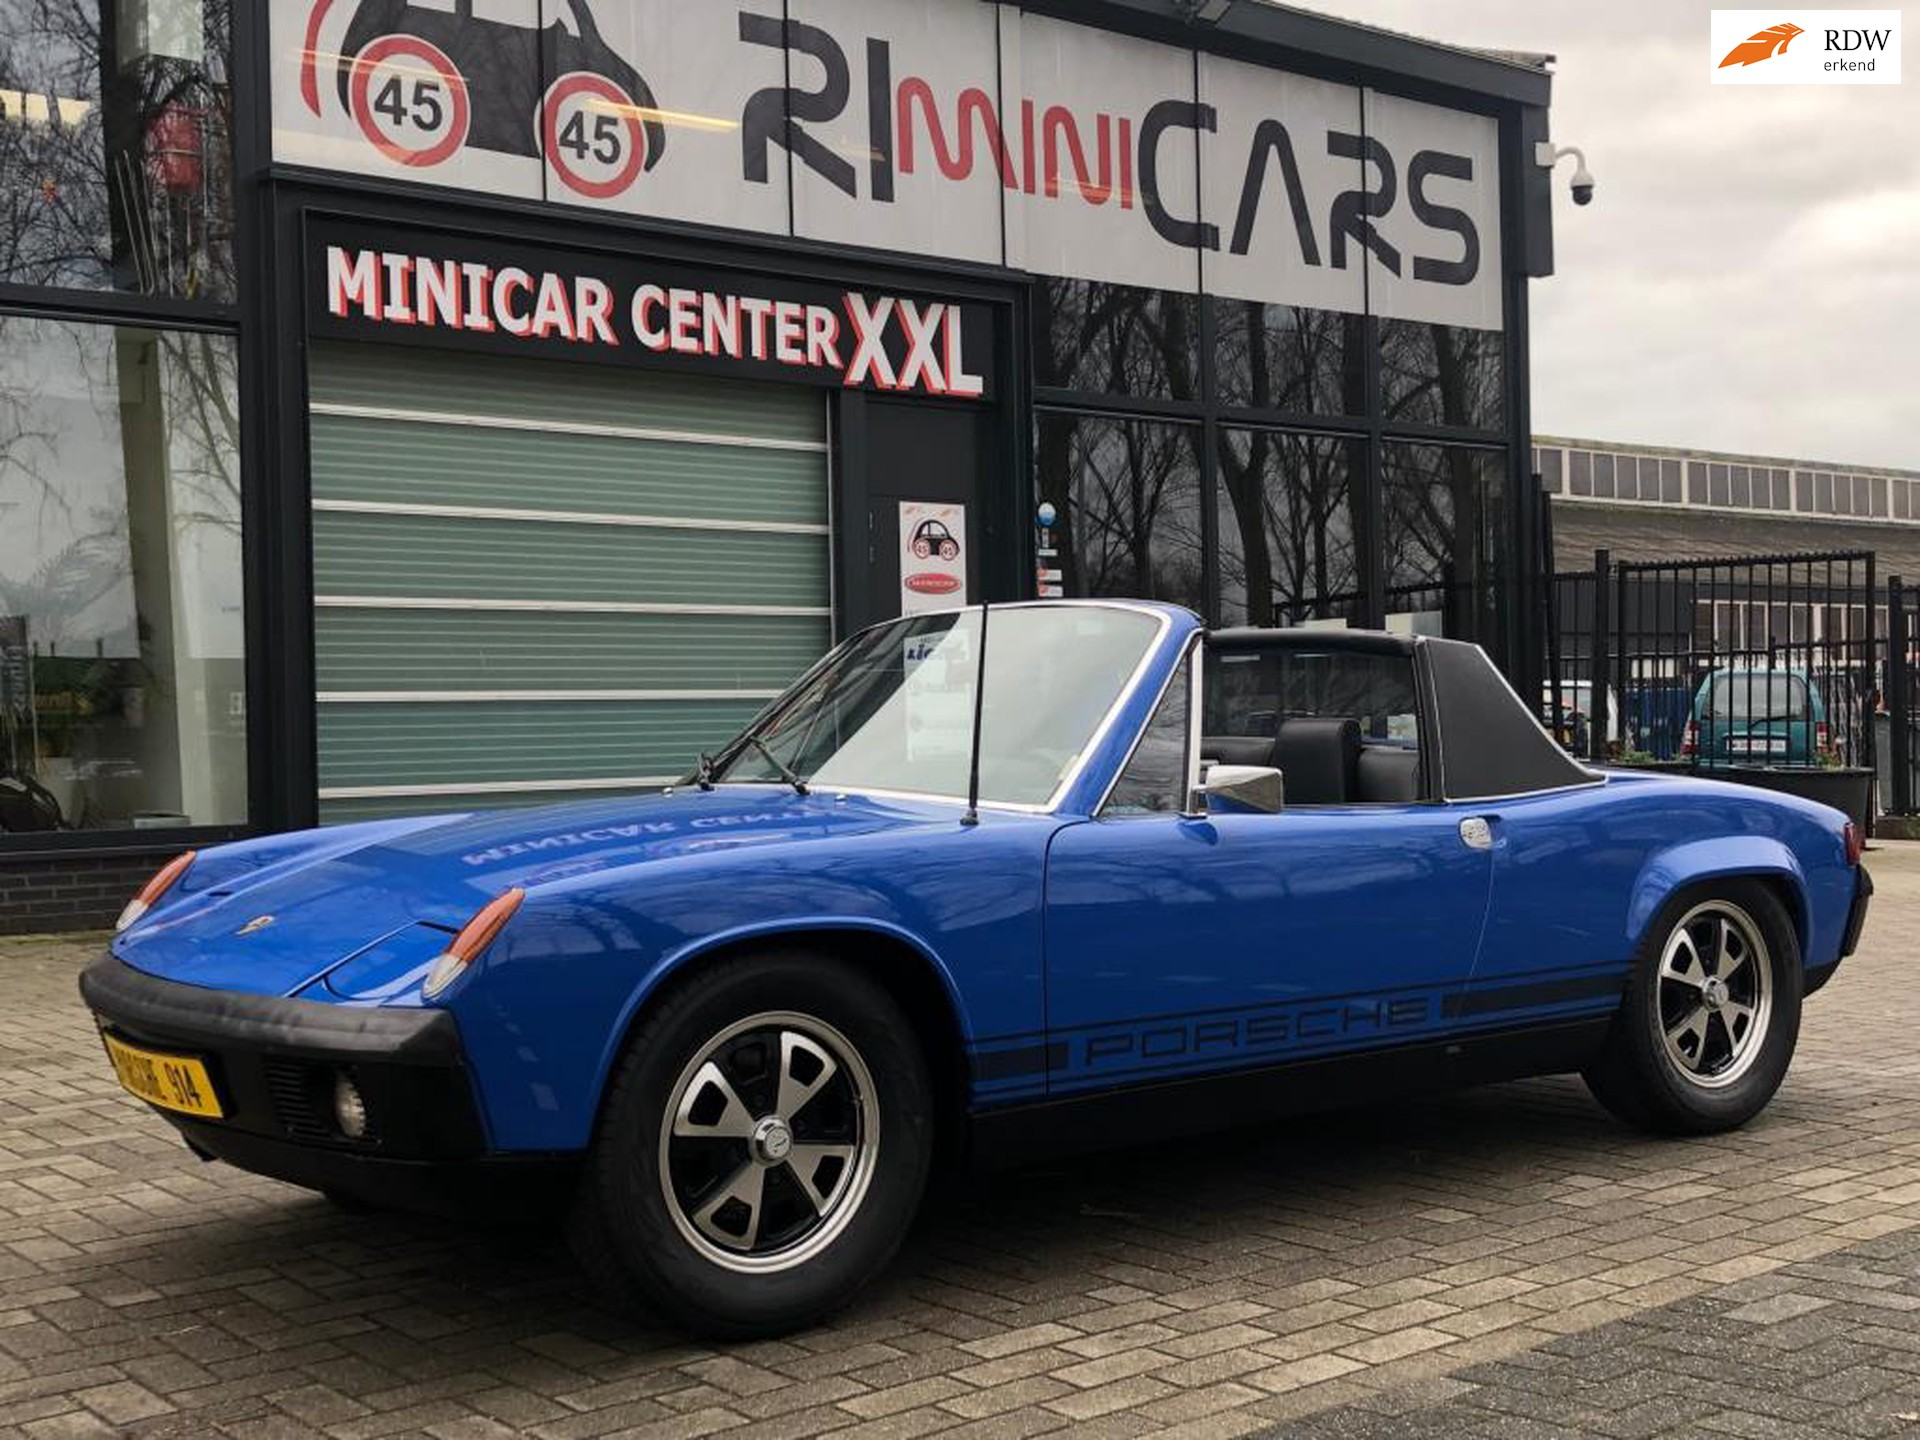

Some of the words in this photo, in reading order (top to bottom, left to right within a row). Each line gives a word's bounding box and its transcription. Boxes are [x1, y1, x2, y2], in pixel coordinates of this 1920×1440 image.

[374, 76, 443, 132] 45
[558, 110, 621, 164] 45
[326, 246, 619, 345] MINICAR
[631, 284, 843, 368] CENTER
[842, 293, 984, 394] XXL
[1086, 998, 1429, 1065] PORSCHE
[164, 1062, 202, 1108] 914
